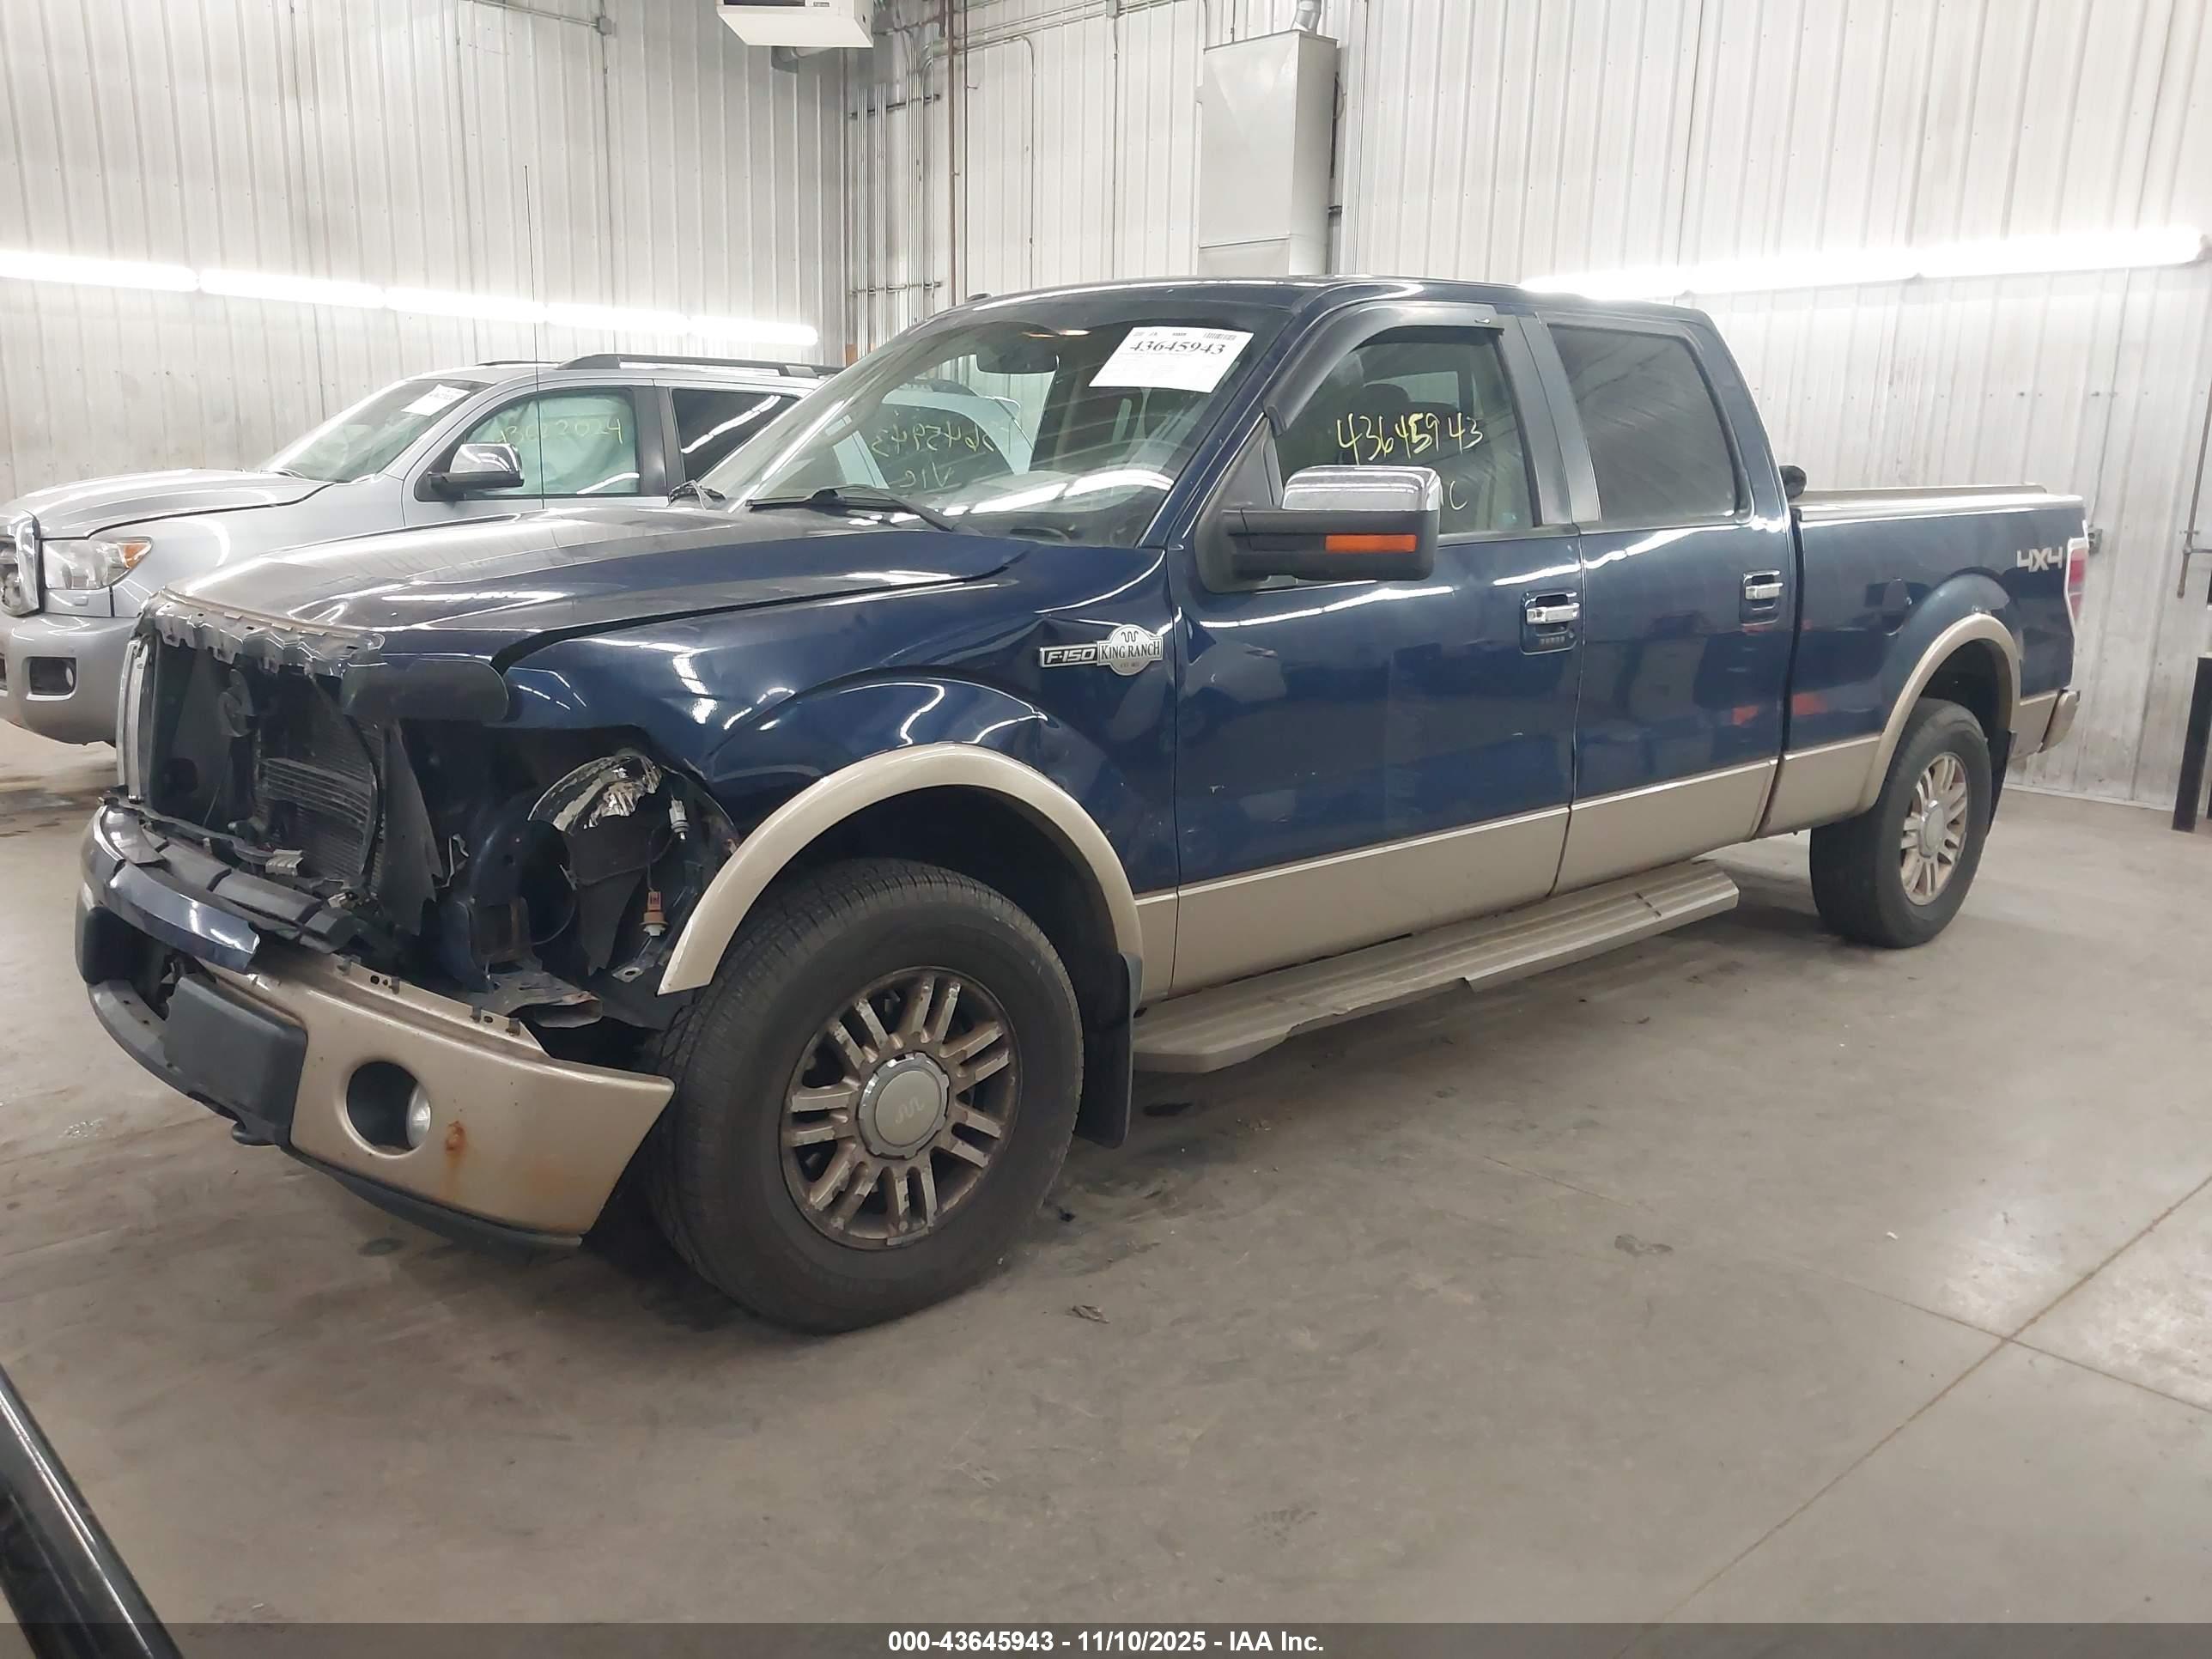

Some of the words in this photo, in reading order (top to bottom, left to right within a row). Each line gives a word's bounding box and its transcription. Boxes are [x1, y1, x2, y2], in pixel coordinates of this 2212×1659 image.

[1129, 340, 1226, 355] 43645943
[1336, 413, 1485, 466] 43645943
[1046, 647, 1097, 664] F-150
[1101, 644, 1126, 660] KING
[1127, 641, 1160, 658] RANCH
